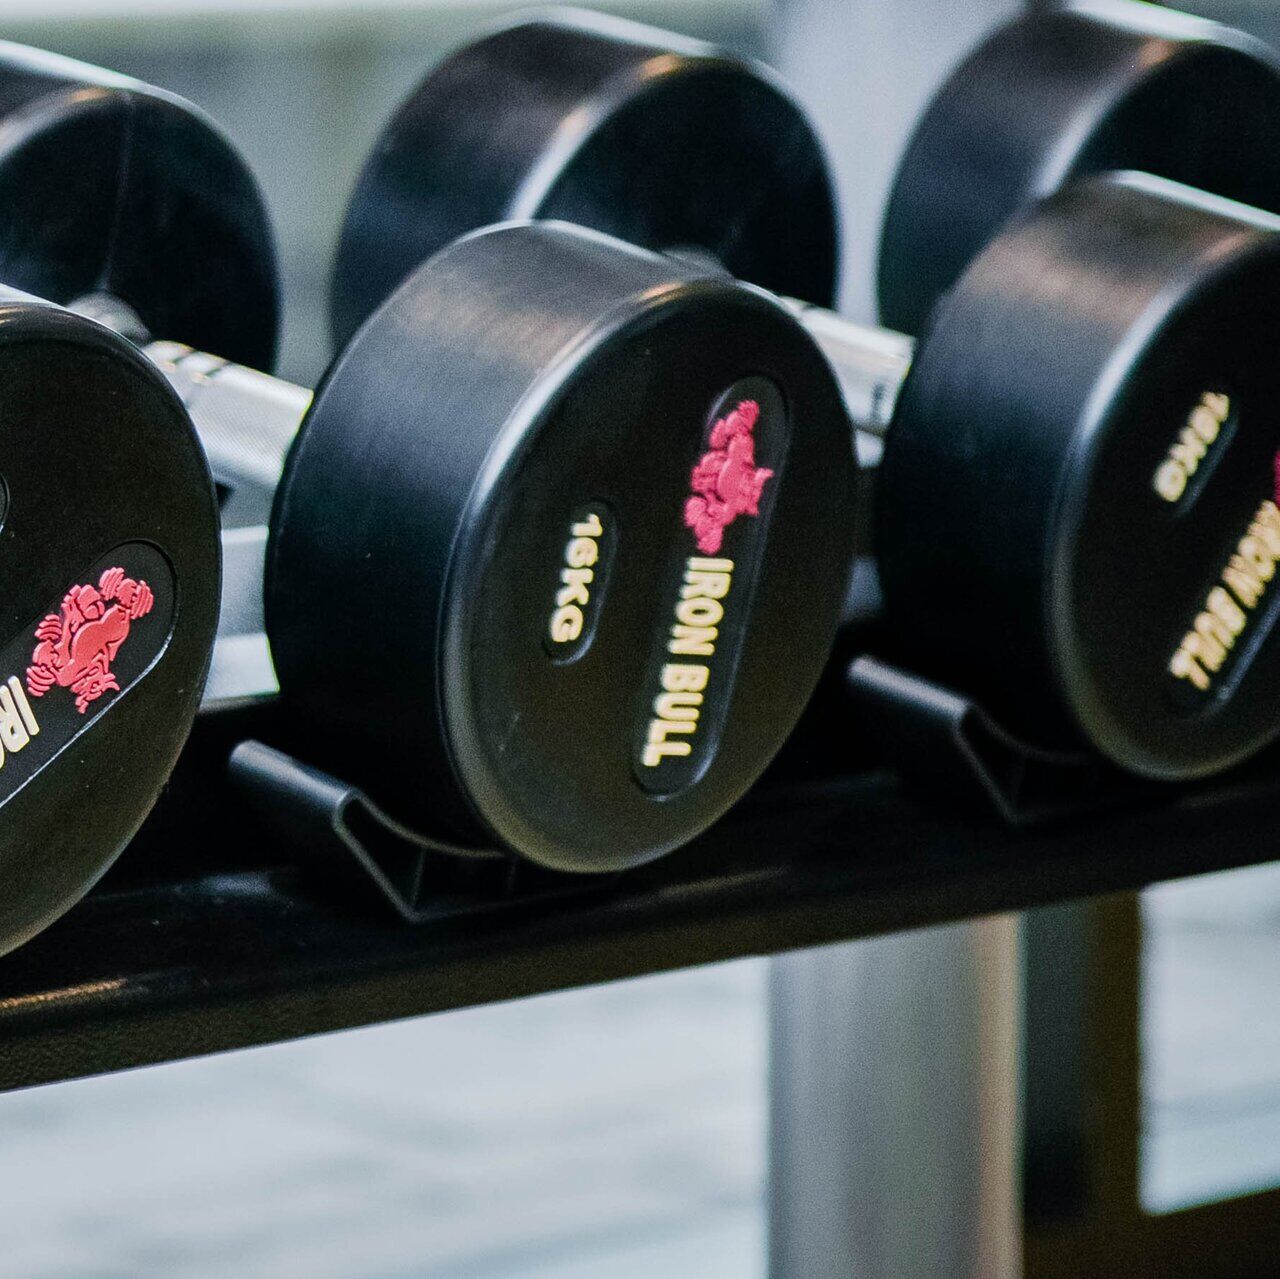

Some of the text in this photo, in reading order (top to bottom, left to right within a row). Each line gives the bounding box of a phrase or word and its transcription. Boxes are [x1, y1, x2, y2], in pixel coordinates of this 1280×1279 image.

[549, 513, 603, 643] 16KG
[1169, 586, 1246, 691] BULL
[642, 557, 735, 767] IRON BULL
